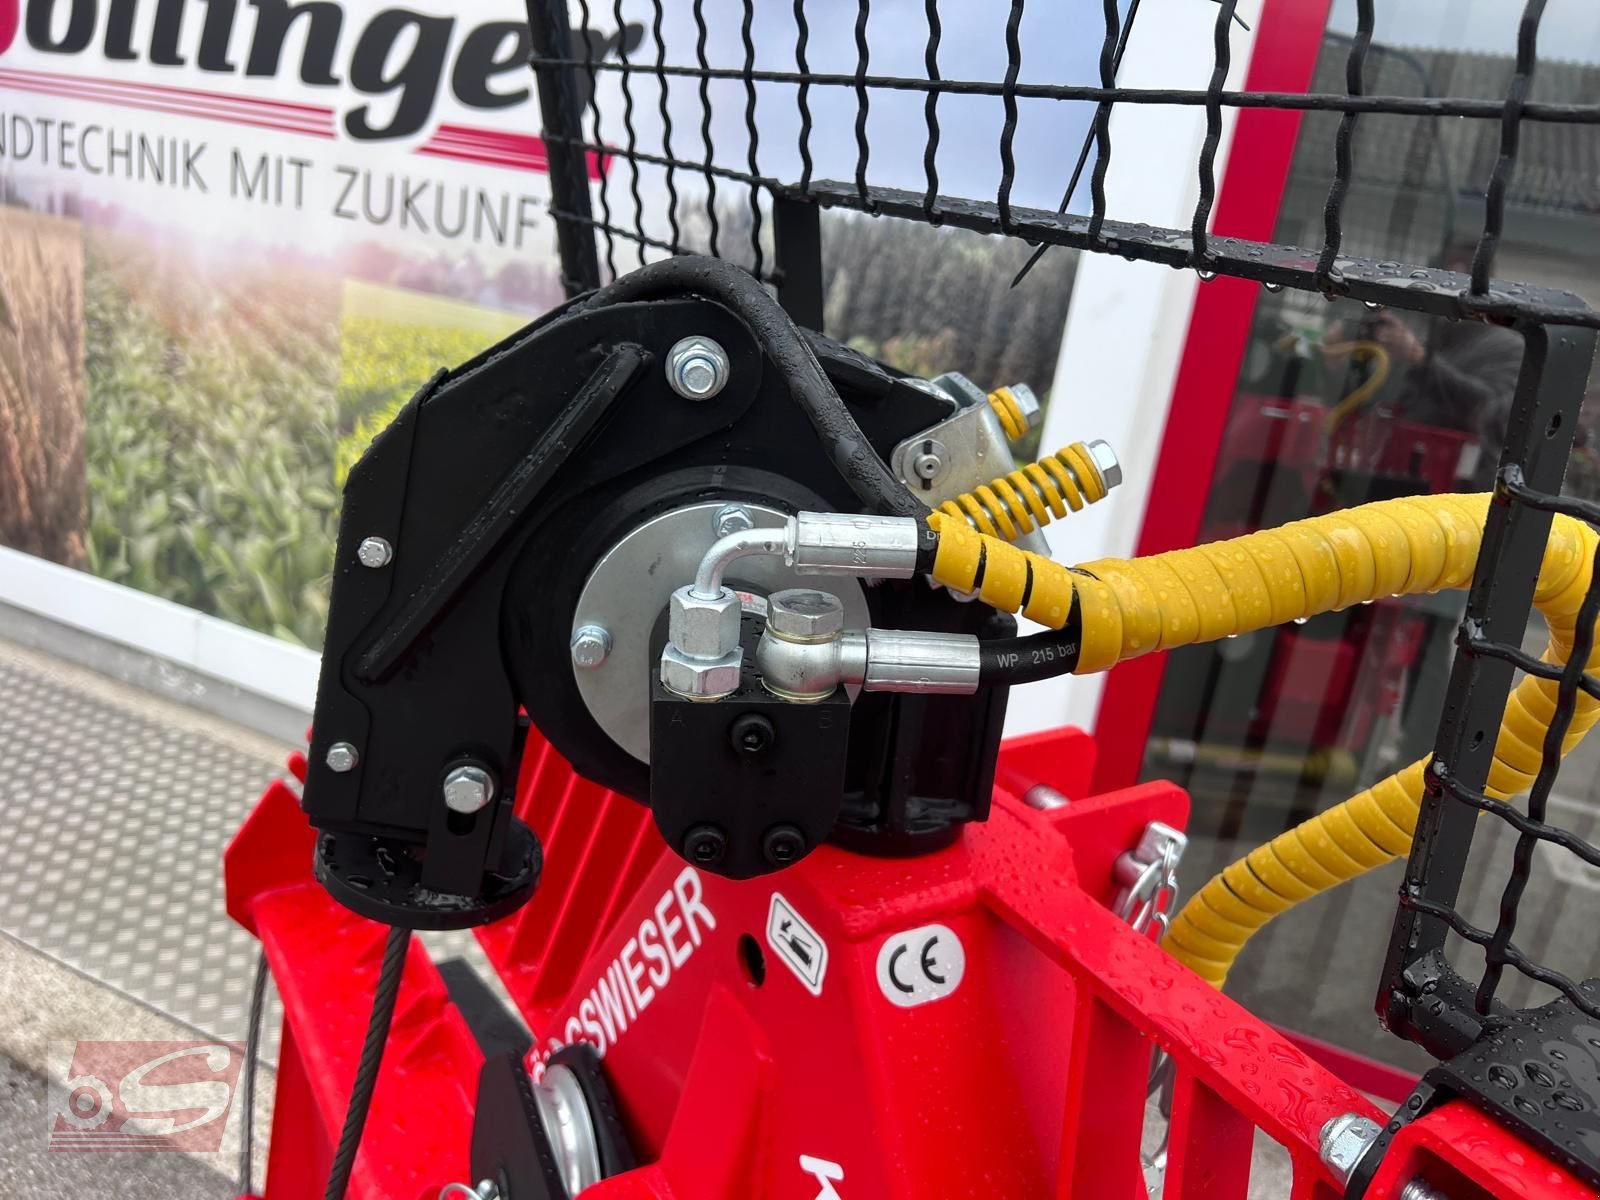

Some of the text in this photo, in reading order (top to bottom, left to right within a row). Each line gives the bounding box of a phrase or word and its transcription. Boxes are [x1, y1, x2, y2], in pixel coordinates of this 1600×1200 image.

[230, 147, 313, 210] MIT
[332, 164, 549, 250] ZUKUNF
[996, 643, 1077, 668] WP 215 bar
[888, 935, 946, 994] CE
